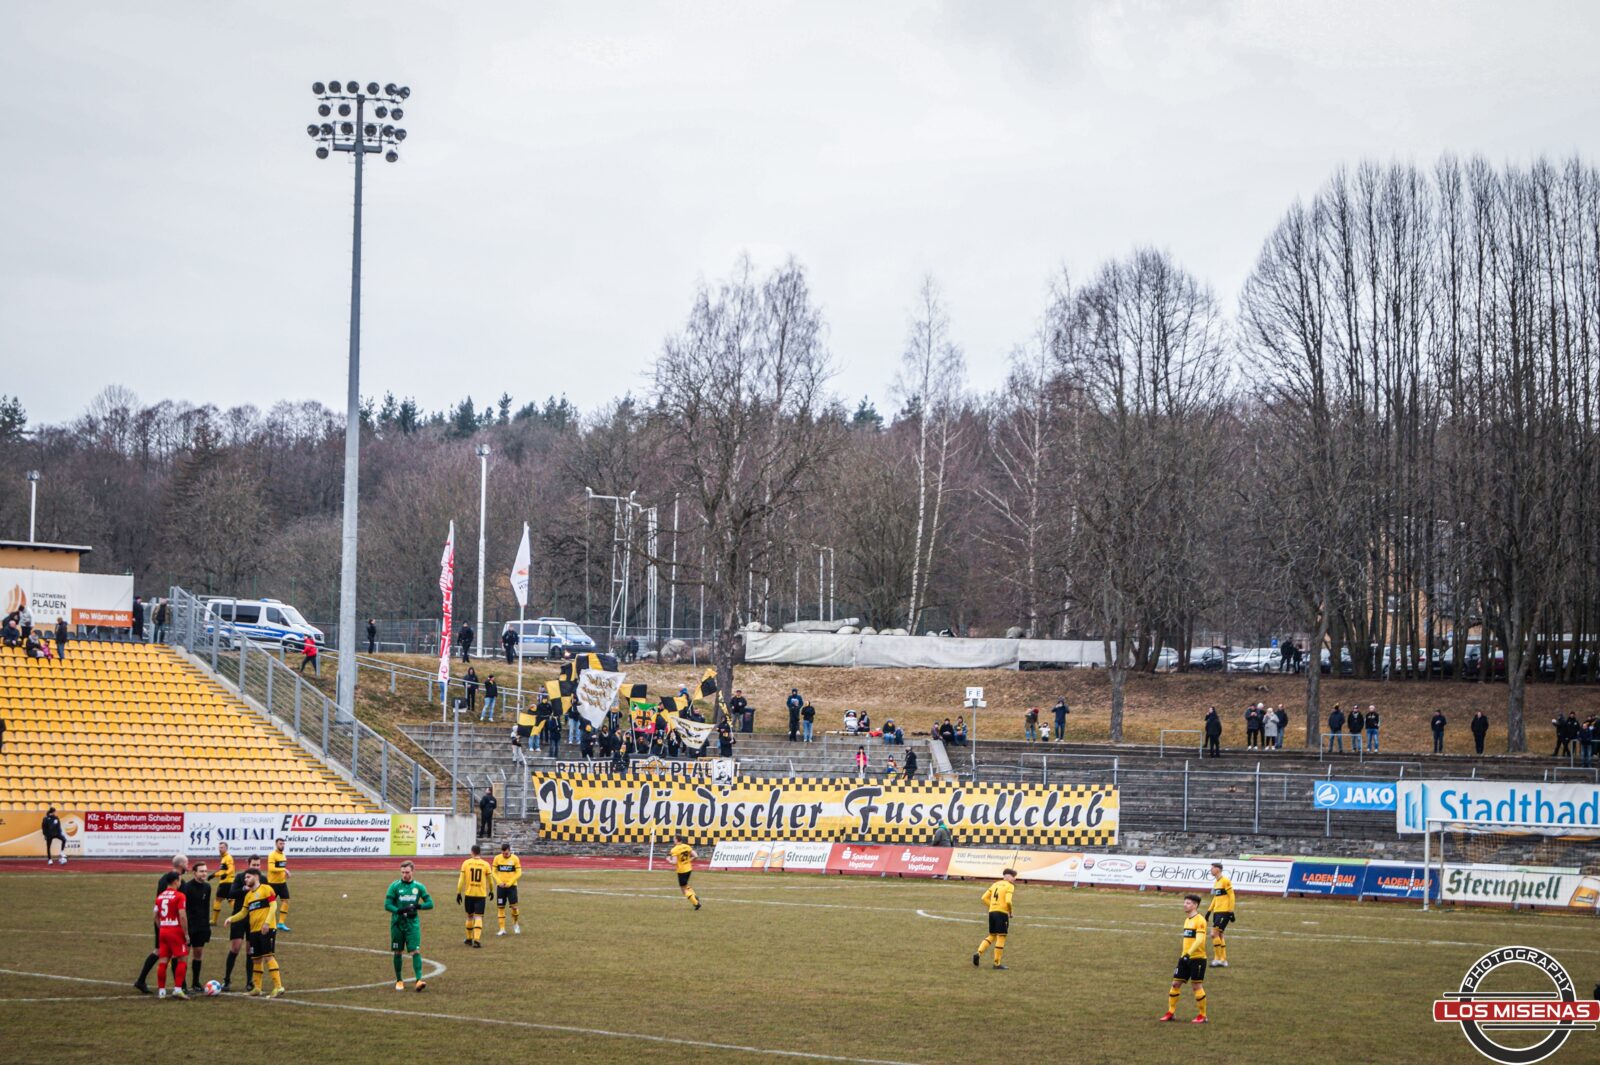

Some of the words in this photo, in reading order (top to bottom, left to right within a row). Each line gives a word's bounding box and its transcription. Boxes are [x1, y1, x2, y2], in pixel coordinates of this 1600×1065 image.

[32, 599, 66, 609] PLAUEN
[1344, 786, 1395, 804] JAKO
[539, 780, 823, 835] Vogtländischer
[844, 786, 1105, 834] Fussballclub
[1440, 788, 1600, 829] Stadtbad
[87, 813, 99, 821] Kfz
[105, 813, 146, 821] Prüfzentrum
[147, 813, 182, 822] Scheibner
[280, 814, 318, 831] EKD
[324, 817, 390, 826] Einbauküchen-Direkt
[112, 822, 182, 832] Sachverständigenbüro
[217, 828, 275, 841] SIRTAKI
[289, 845, 380, 853] www.einbaukuechen-direkt.de
[713, 851, 755, 864] Sternquell
[786, 851, 828, 865] Sternquell
[852, 853, 880, 861] Sparkasse
[910, 855, 940, 863] Sparkasse
[848, 861, 875, 869] Vogtland
[908, 863, 934, 872] Vogtland
[470, 867, 483, 883] 10
[1150, 864, 1263, 884] elektrotehnik
[1445, 868, 1562, 901] Sternquell
[993, 887, 999, 902] 4
[161, 899, 169, 917] 5
